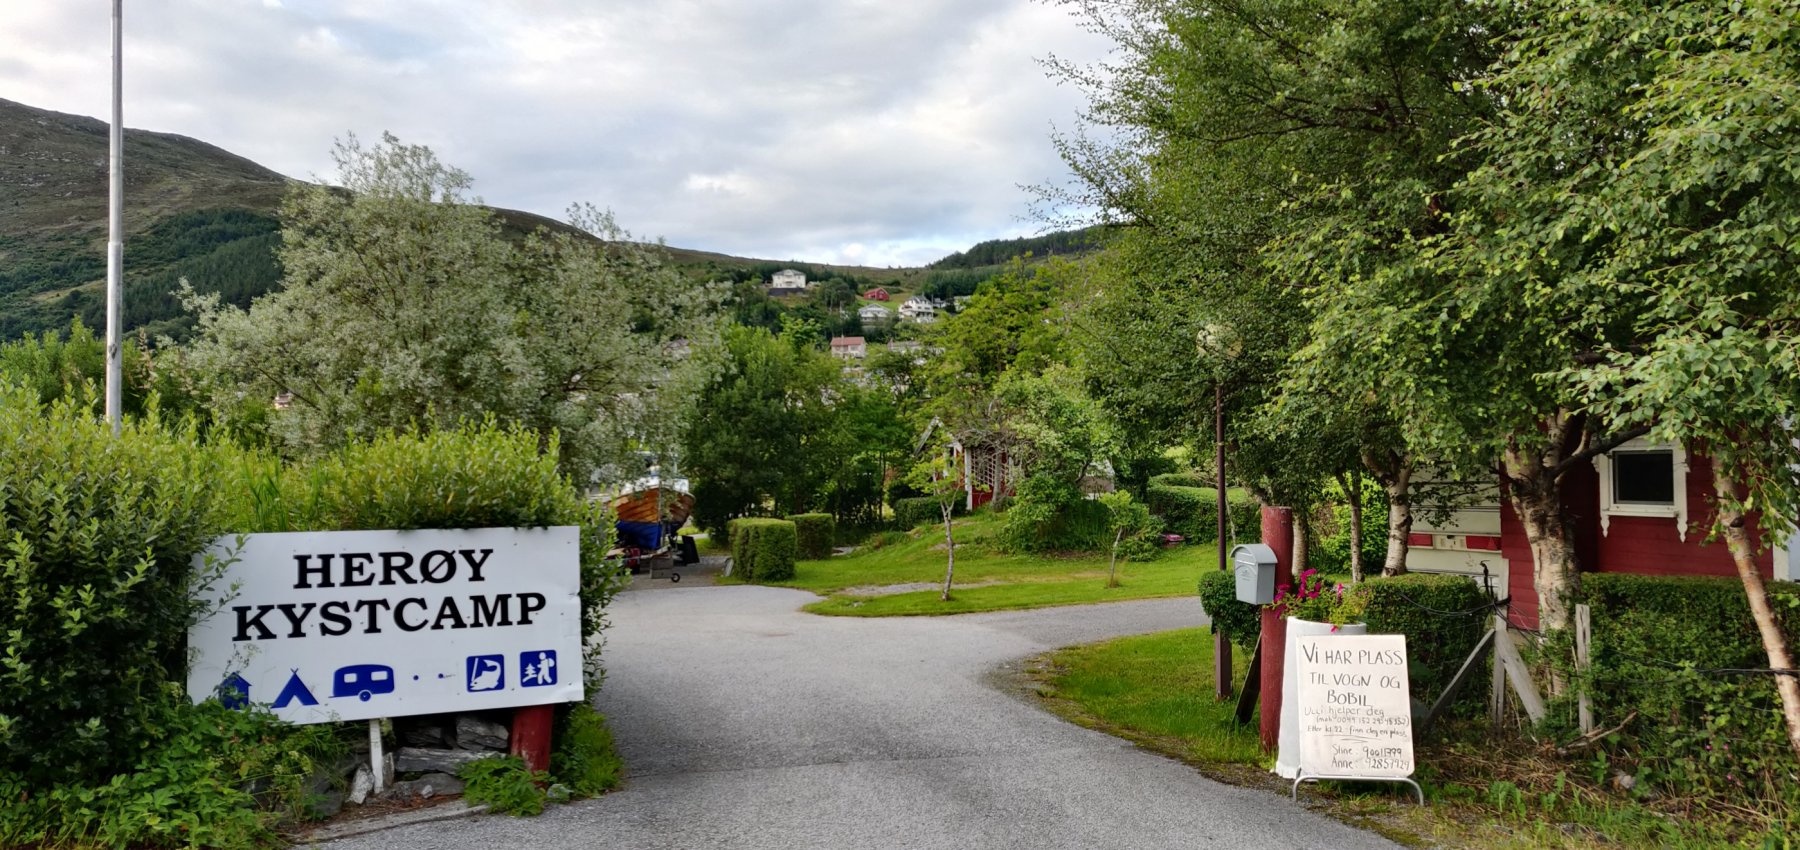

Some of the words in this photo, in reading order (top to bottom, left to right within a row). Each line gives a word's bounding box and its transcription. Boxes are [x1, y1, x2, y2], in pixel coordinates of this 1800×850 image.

[293, 548, 494, 590] HERØY
[231, 592, 547, 643] KYSTCAMP
[1325, 650, 1352, 665] HAR
[1358, 650, 1403, 665] PLASS
[1310, 672, 1328, 685] TIL
[1333, 674, 1371, 686] VOGN
[1380, 676, 1400, 689] OG
[1327, 689, 1373, 707] BOBIL
[1366, 705, 1384, 717] deg
